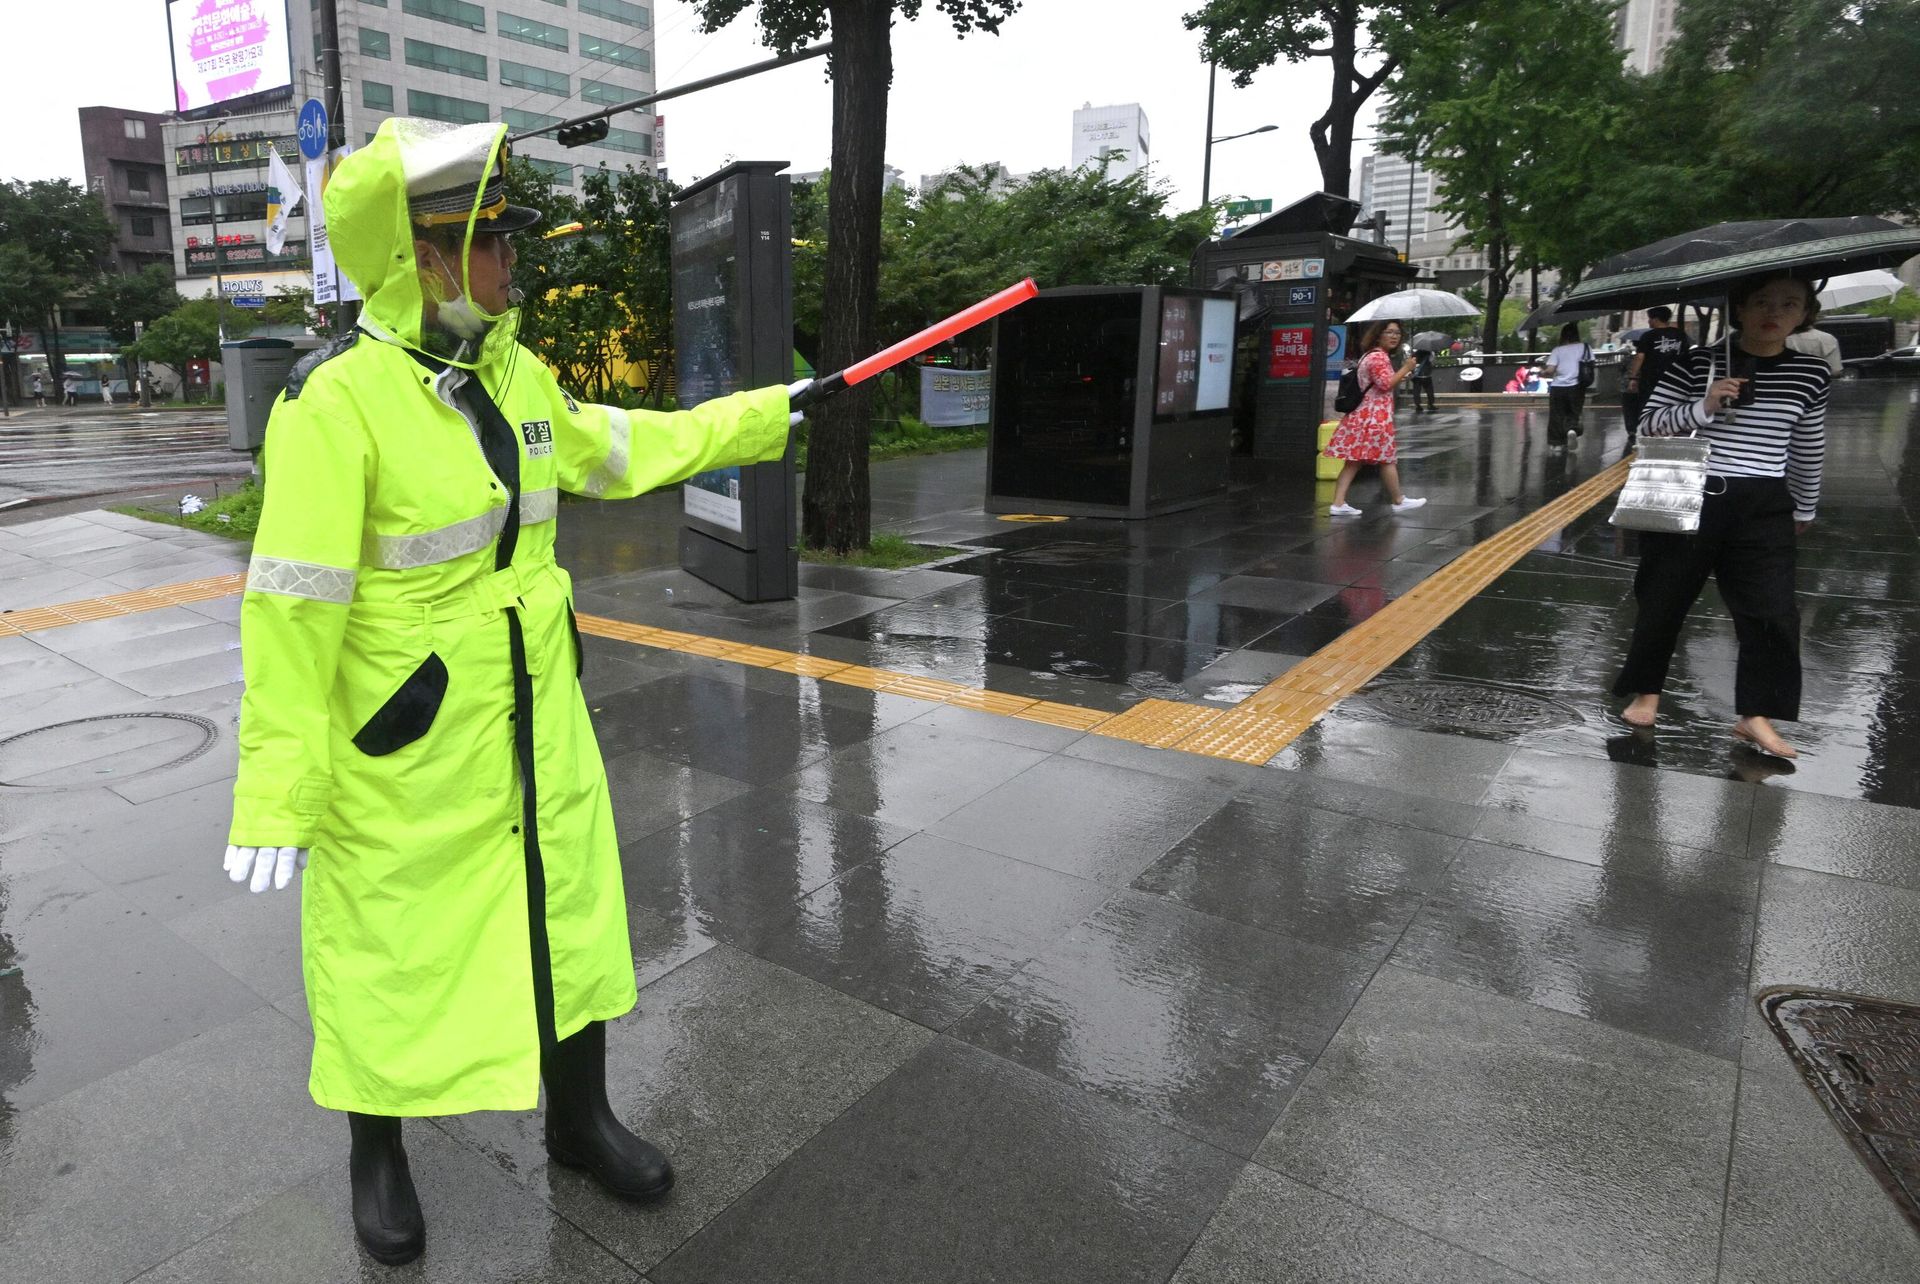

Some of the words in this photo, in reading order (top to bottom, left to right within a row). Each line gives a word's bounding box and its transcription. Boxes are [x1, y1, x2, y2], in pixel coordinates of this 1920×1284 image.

[656, 131, 665, 157] 다이소
[236, 182, 267, 193] STUDIO
[223, 280, 263, 292] HOLLYS
[1292, 292, 1312, 301] 90-1
[1165, 307, 1186, 320] 누구나
[1281, 331, 1303, 344] 복권
[1275, 343, 1308, 356] 판매점
[934, 375, 950, 391] 일본
[951, 375, 975, 391] 방사능
[523, 422, 551, 443] 경찰
[529, 445, 552, 456] POLICE
